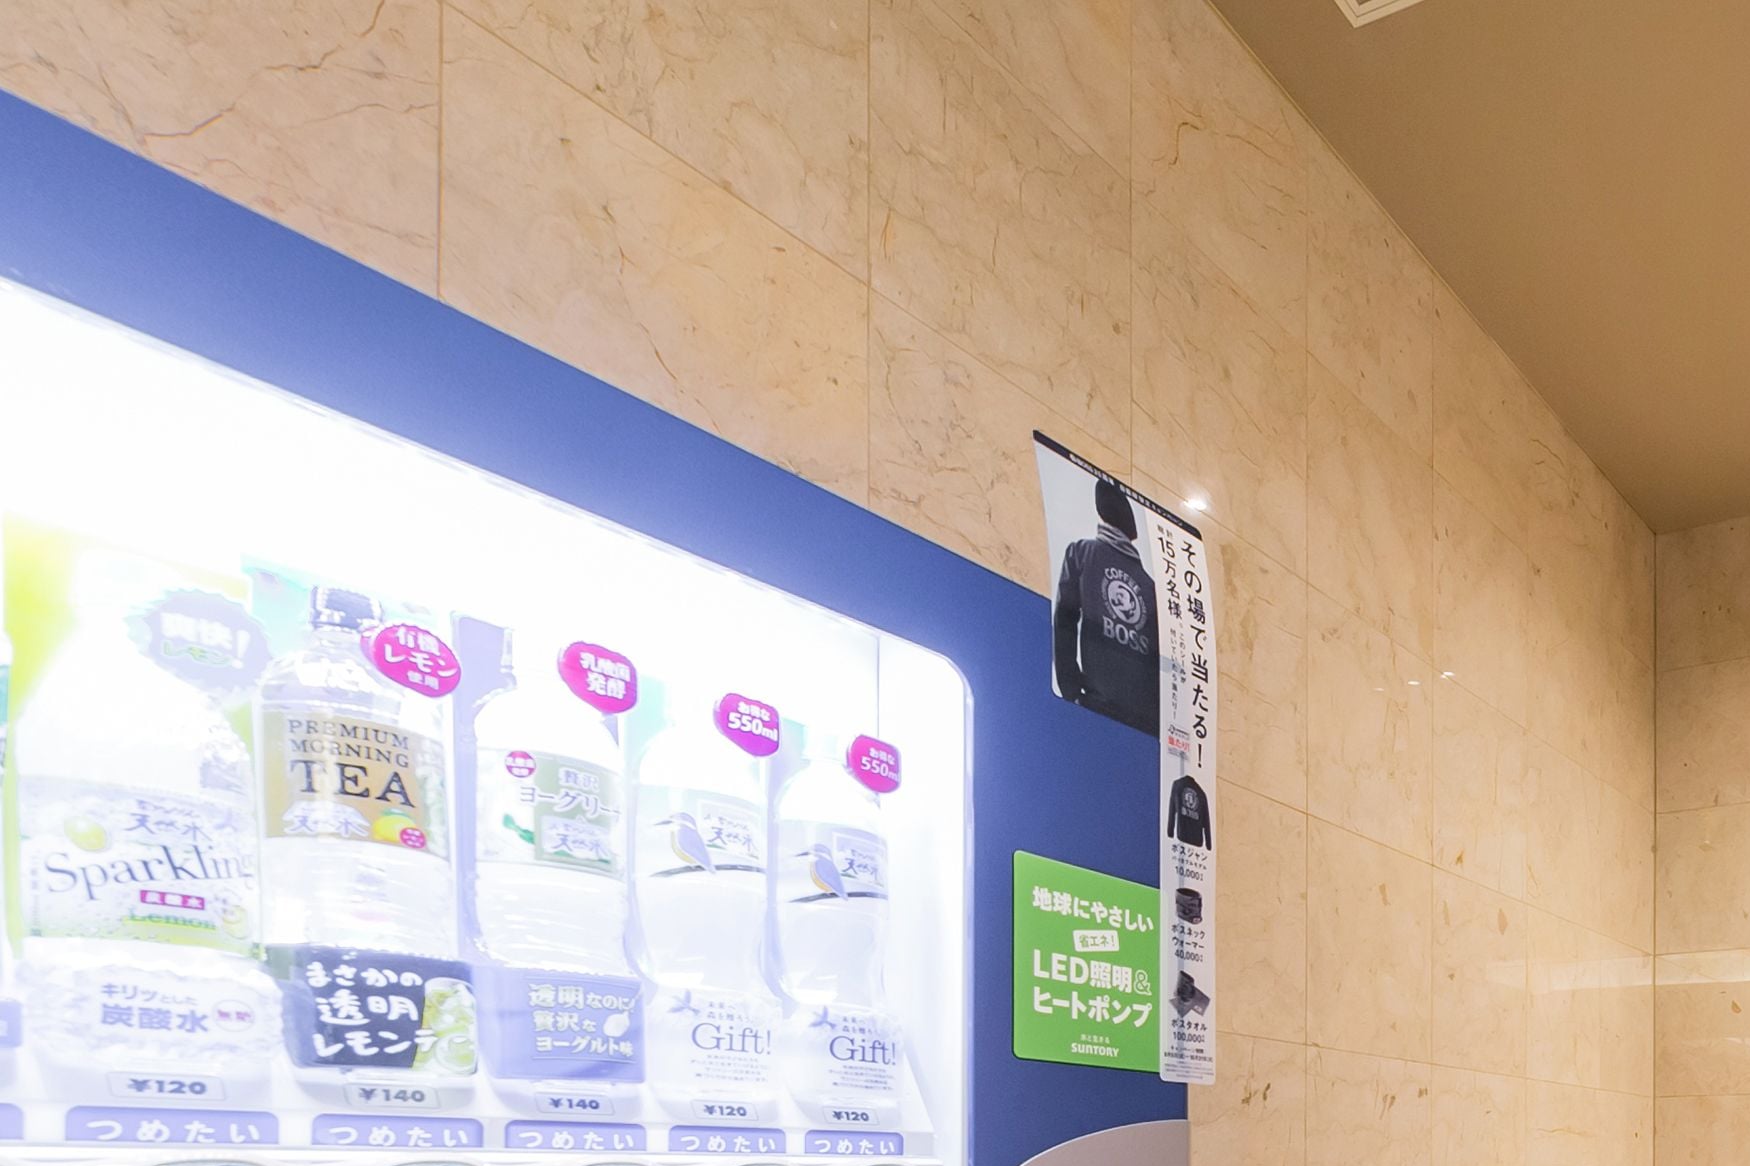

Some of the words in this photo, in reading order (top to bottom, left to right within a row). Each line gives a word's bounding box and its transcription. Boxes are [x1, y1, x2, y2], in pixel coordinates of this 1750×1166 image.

[1105, 567, 1141, 593] COFFEE
[1103, 616, 1149, 654] BOSS
[384, 643, 458, 677] レモン
[288, 718, 409, 751] PREMIUM
[728, 712, 778, 742] 550ml
[289, 739, 409, 769] MORNING
[289, 759, 416, 809] TEA
[44, 844, 255, 903] Sparkling
[1032, 886, 1154, 932] 地球にやさしい
[306, 962, 423, 987] まさかの
[1033, 949, 1152, 996] LED照明&
[100, 983, 199, 1006] キリッとした
[1033, 986, 1153, 1028] ヒートポンプ
[100, 1003, 209, 1034] 炭酸水
[315, 990, 419, 1026] 透明
[536, 1036, 633, 1057] ヨーグルト味
[691, 1022, 771, 1055] Gift!
[829, 1036, 896, 1066] Gift!
[1071, 1043, 1119, 1057] SUNTORY
[127, 1078, 208, 1095] ¥120
[358, 1088, 426, 1104] ¥140
[549, 1097, 601, 1110] ¥140
[703, 1103, 748, 1117] ¥120
[832, 1111, 870, 1122] ¥120
[86, 1119, 261, 1143] つめたい
[329, 1126, 468, 1147] つめたい
[518, 1131, 635, 1150] つめたい
[681, 1135, 776, 1152] つめたい
[815, 1139, 895, 1155] つめたい
